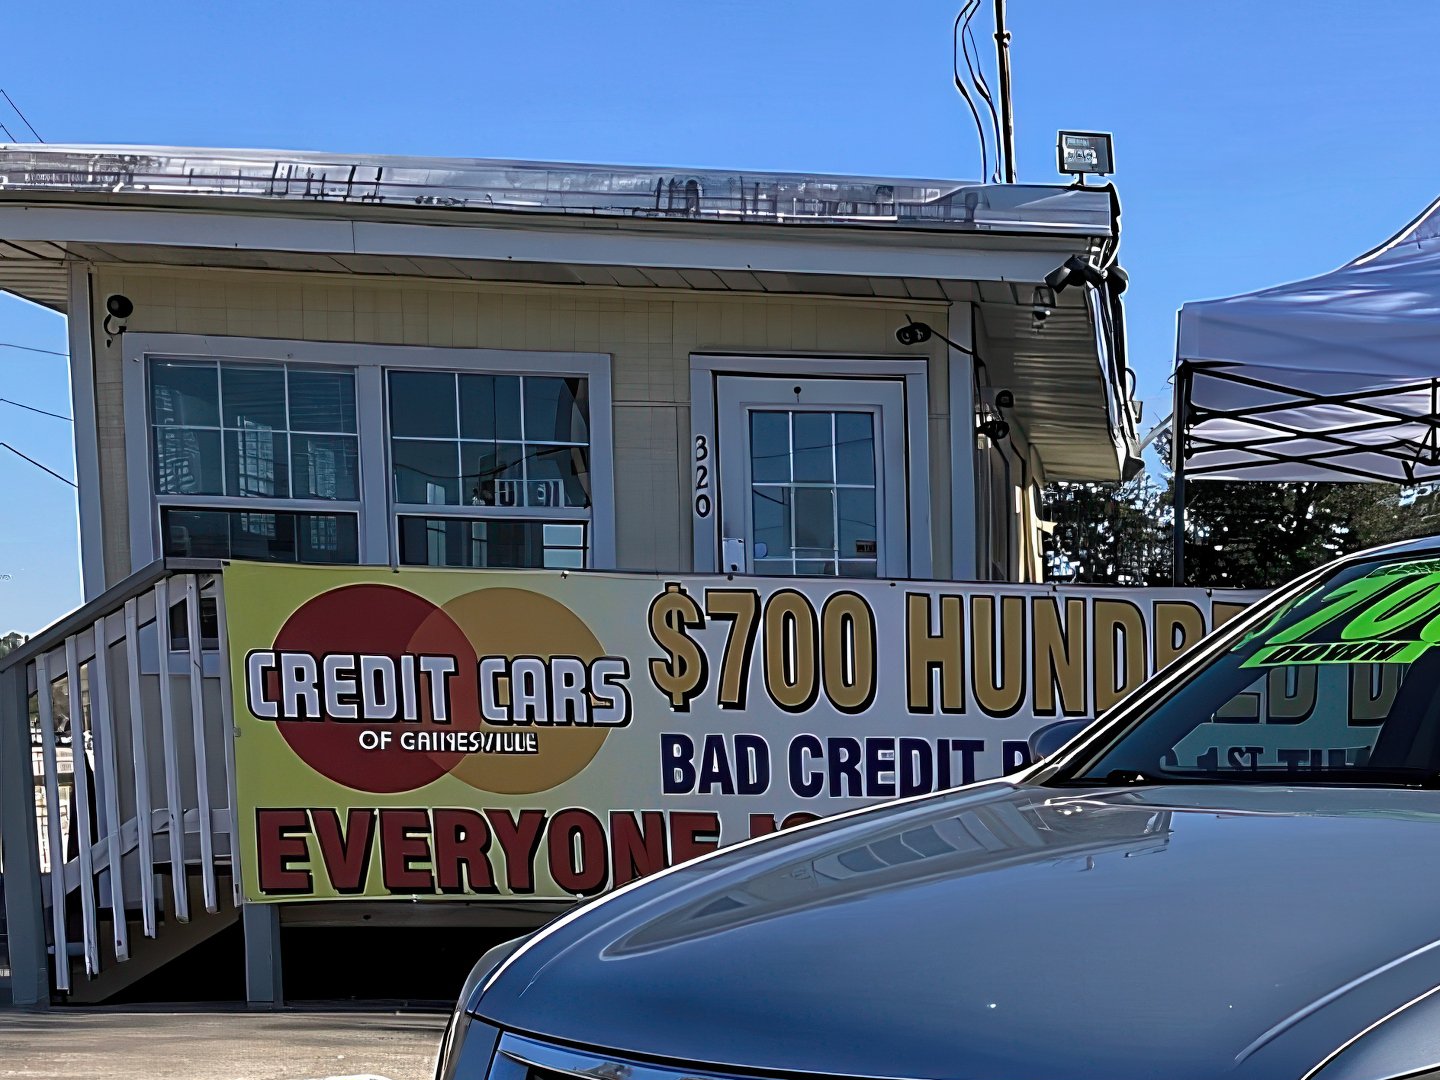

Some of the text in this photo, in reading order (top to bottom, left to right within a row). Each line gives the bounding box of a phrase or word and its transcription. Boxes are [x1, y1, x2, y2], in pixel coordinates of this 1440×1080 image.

[695, 434, 711, 518] 320
[648, 582, 877, 714] $700
[1258, 642, 1411, 665] DOWN
[245, 648, 633, 728] CREDIT CARS
[358, 730, 538, 752] OF GAINESVILLE
[661, 733, 769, 796] BAD
[788, 738, 984, 798] CREDIT
